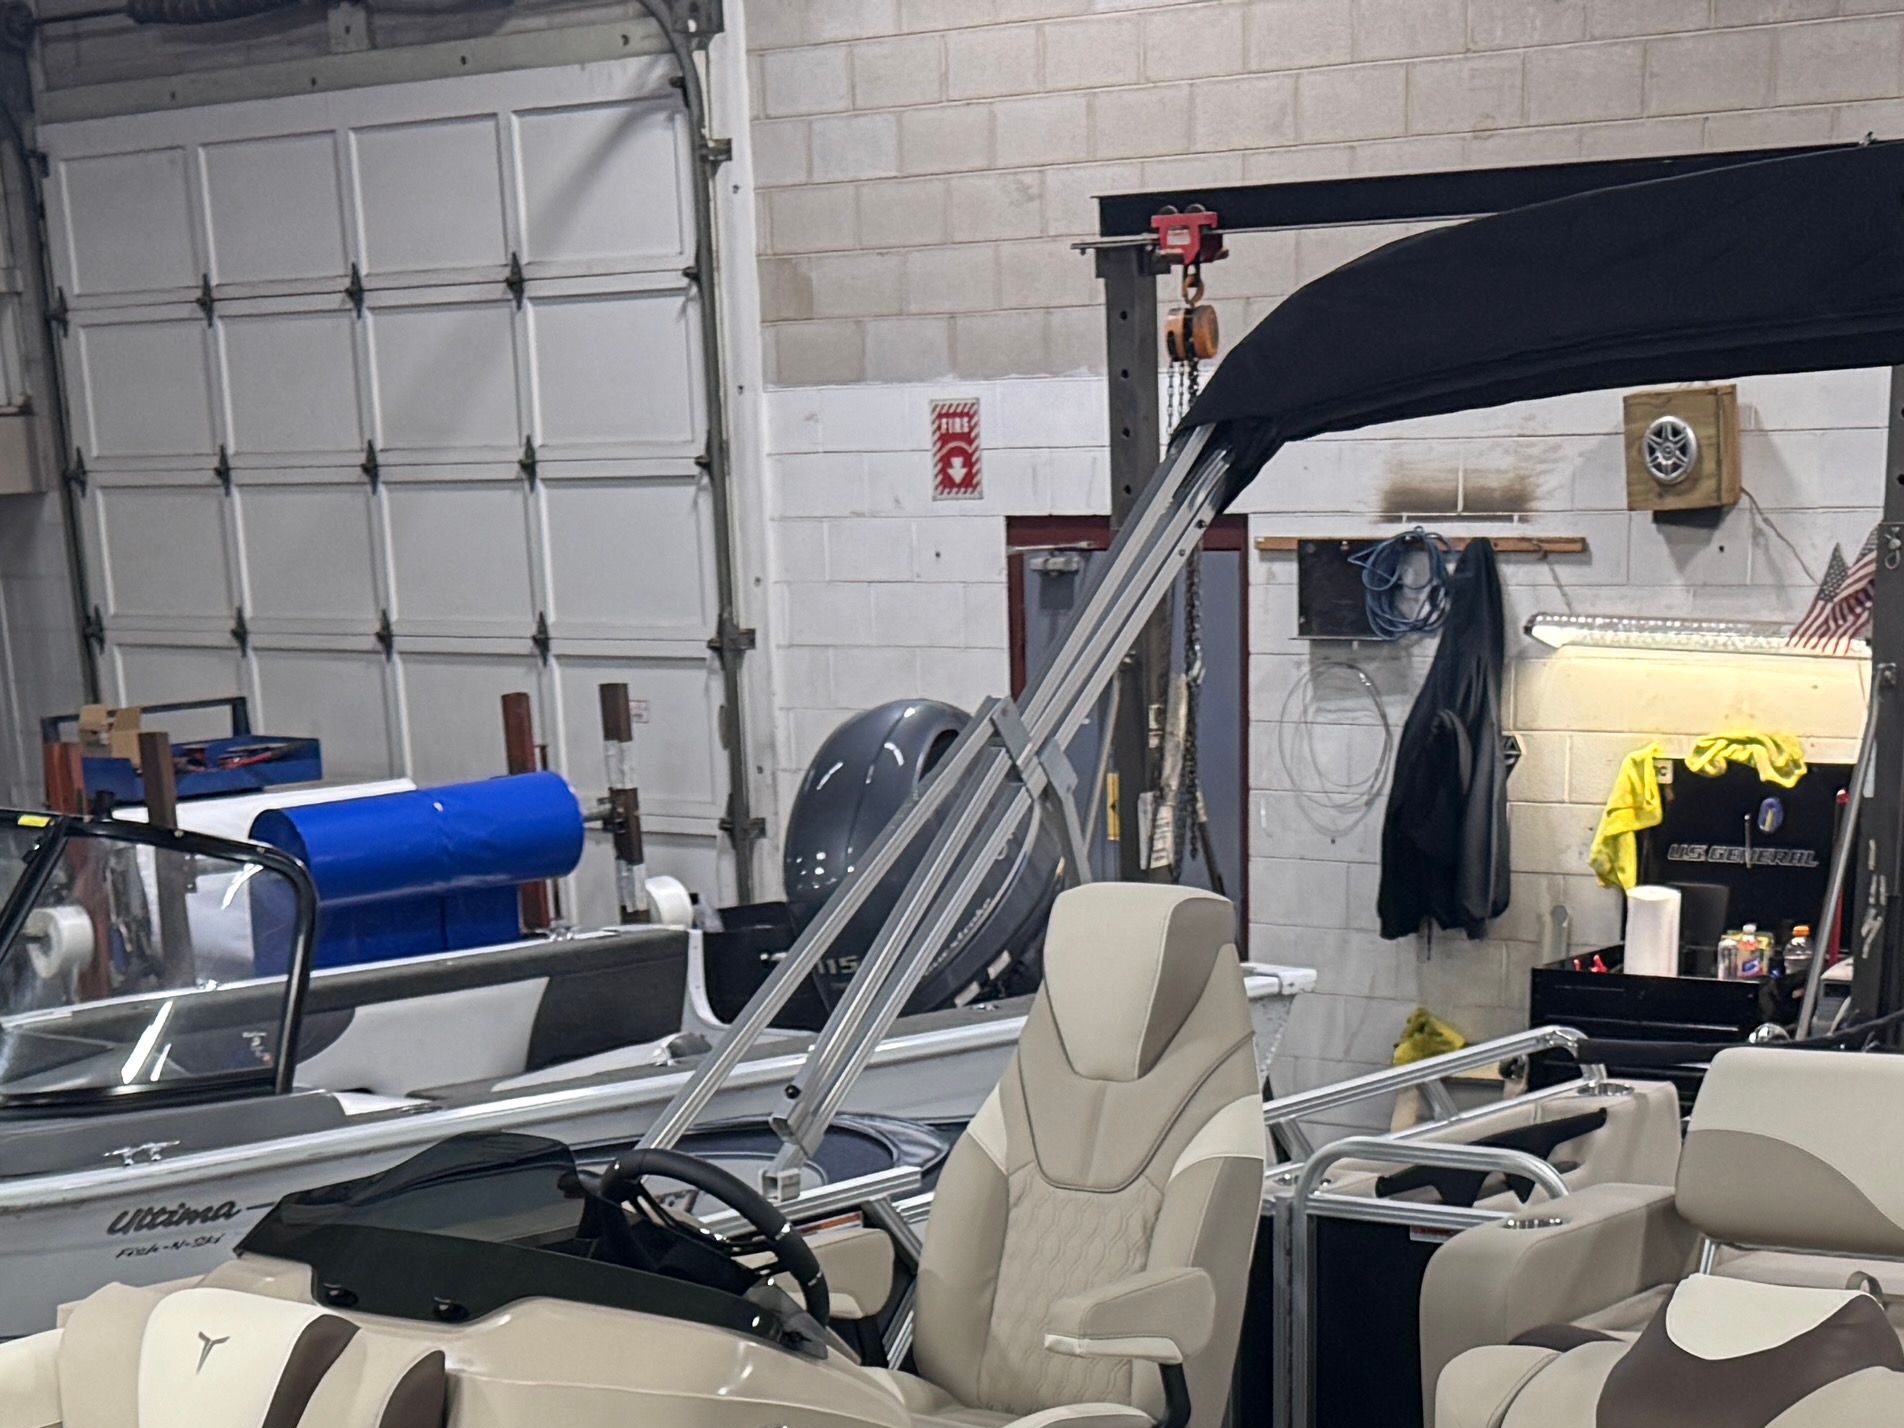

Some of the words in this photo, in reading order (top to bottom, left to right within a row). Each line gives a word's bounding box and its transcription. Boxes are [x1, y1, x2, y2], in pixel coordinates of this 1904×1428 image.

[939, 417, 971, 434] FIRE
[1707, 845, 1819, 868] GENERAL
[106, 1200, 242, 1236] Ultima
